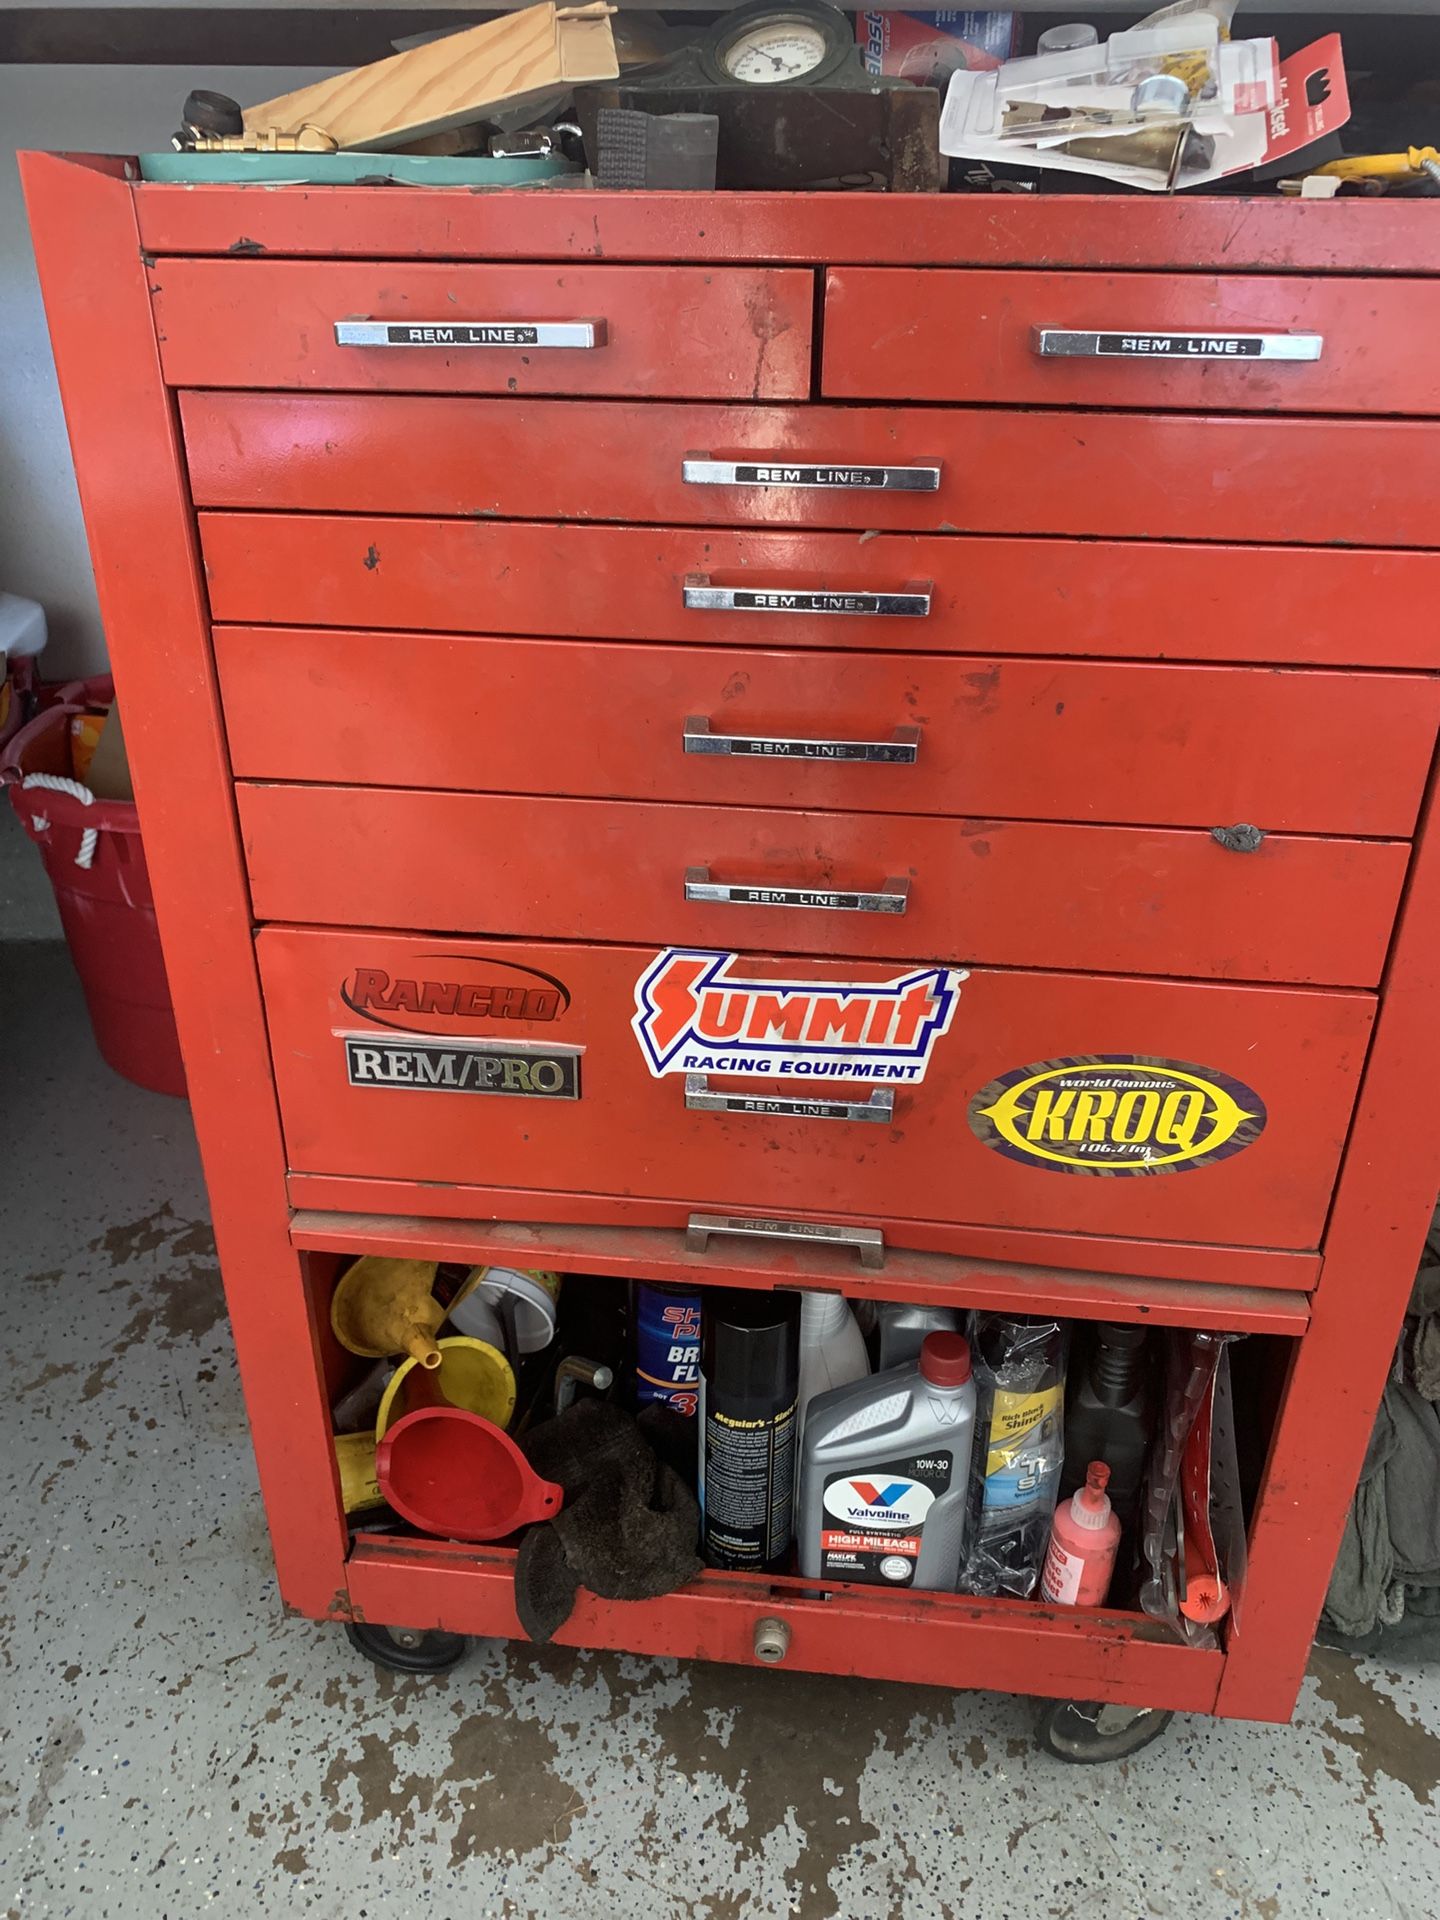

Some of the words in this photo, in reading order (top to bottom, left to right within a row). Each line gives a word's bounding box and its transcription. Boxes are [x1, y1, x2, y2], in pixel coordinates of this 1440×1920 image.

[1270, 77, 1290, 139] kset
[409, 328, 454, 341] REM
[1121, 338, 1171, 352] REM
[756, 469, 800, 481] REM
[753, 595, 796, 607] REM
[750, 743, 790, 754] REM
[748, 891, 786, 902] REM
[351, 967, 560, 1022] RANCHO
[682, 1055, 771, 1072] RACING
[778, 1060, 921, 1079] EQUIPMENT
[1059, 1078, 1109, 1089] world
[1112, 1078, 1176, 1089] famous
[745, 1101, 780, 1112] REM
[1026, 1090, 1206, 1151] KROQ
[662, 1306, 701, 1323] SH
[667, 1346, 700, 1363] BR
[672, 1365, 698, 1382] FL
[669, 1392, 699, 1417] 3
[714, 1411, 765, 1429] Meguiar's
[1002, 1412, 1021, 1421] Rich
[1005, 1409, 1044, 1430] Shine!
[916, 1459, 949, 1470] 10W-30
[847, 1507, 911, 1521] Valvoline
[828, 1535, 861, 1545] HIGH
[863, 1537, 918, 1549] MILEAGE
